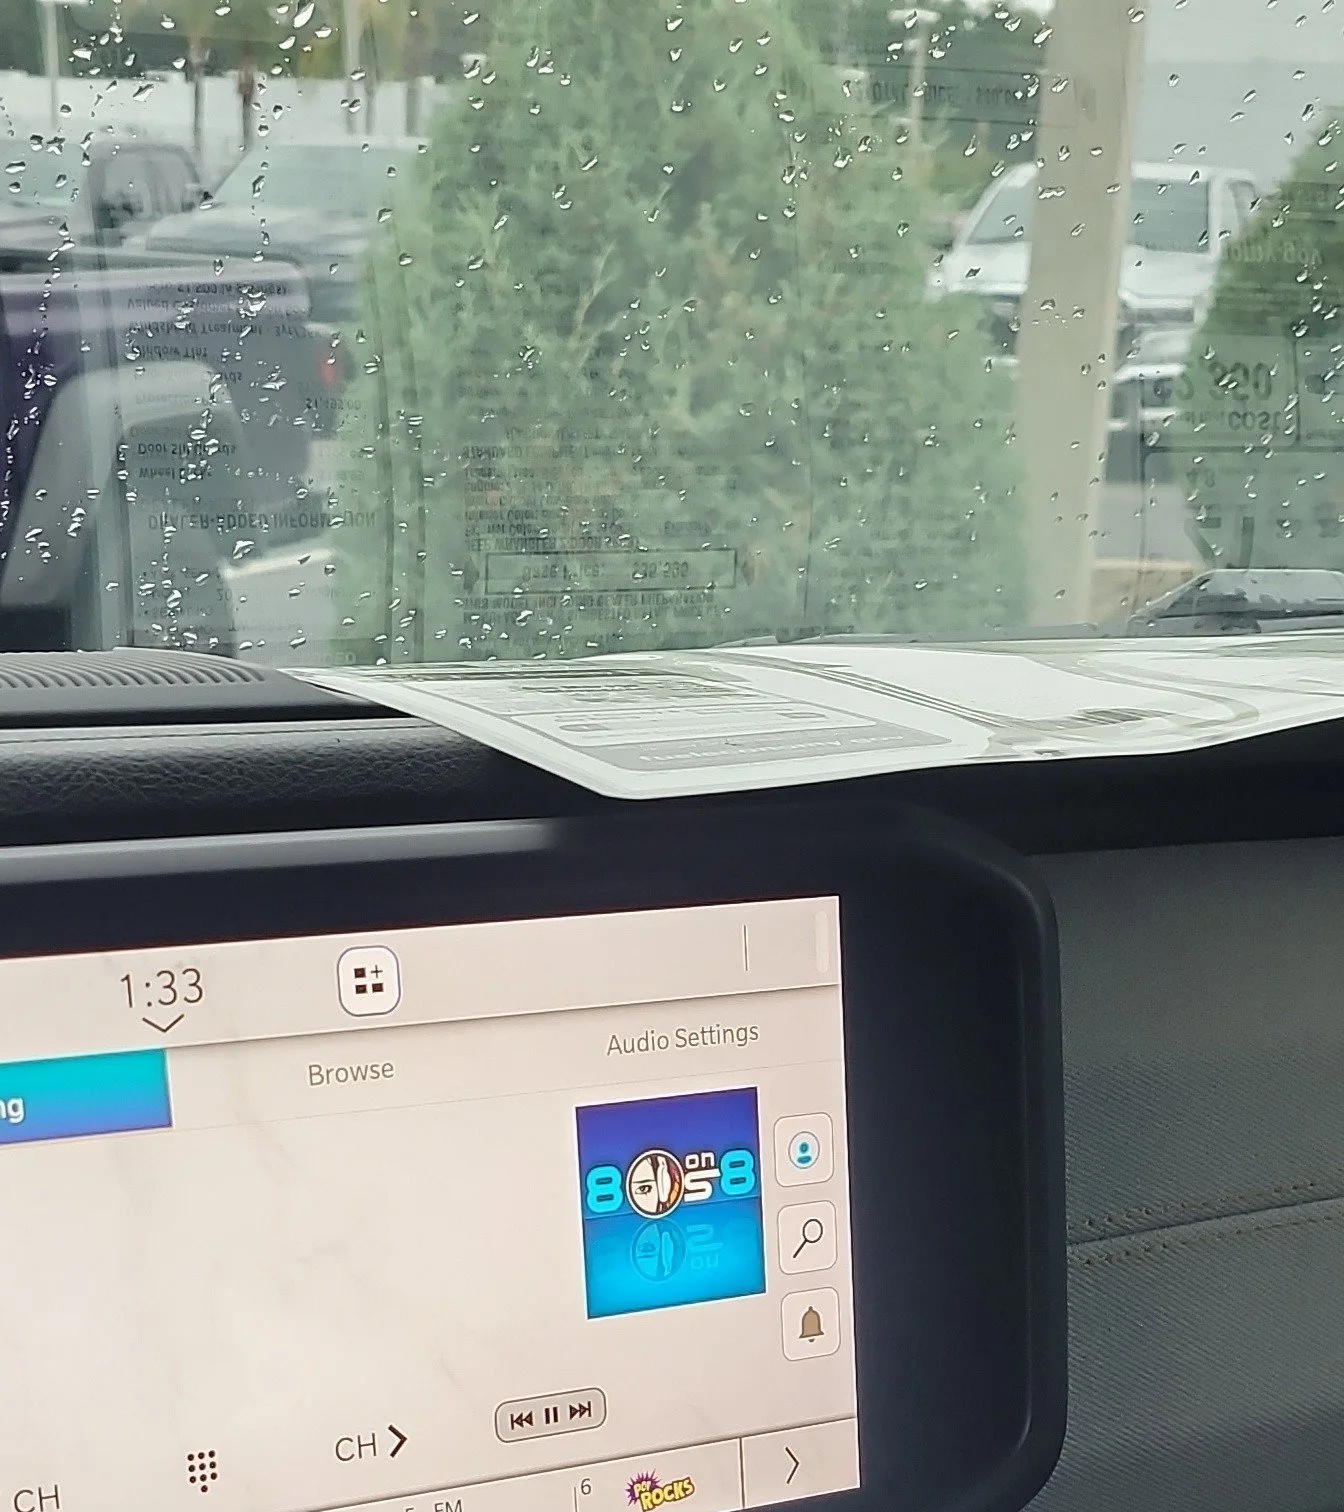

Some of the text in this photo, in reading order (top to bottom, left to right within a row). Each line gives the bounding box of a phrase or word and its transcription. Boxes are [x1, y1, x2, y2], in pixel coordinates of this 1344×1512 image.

[119, 966, 206, 1010] 1:33
[606, 1023, 760, 1057] Audio Settings
[307, 1058, 395, 1088] Browse
[334, 1432, 379, 1463] CH
[580, 1476, 593, 1497] 6
[640, 1476, 696, 1512] ROCKS
